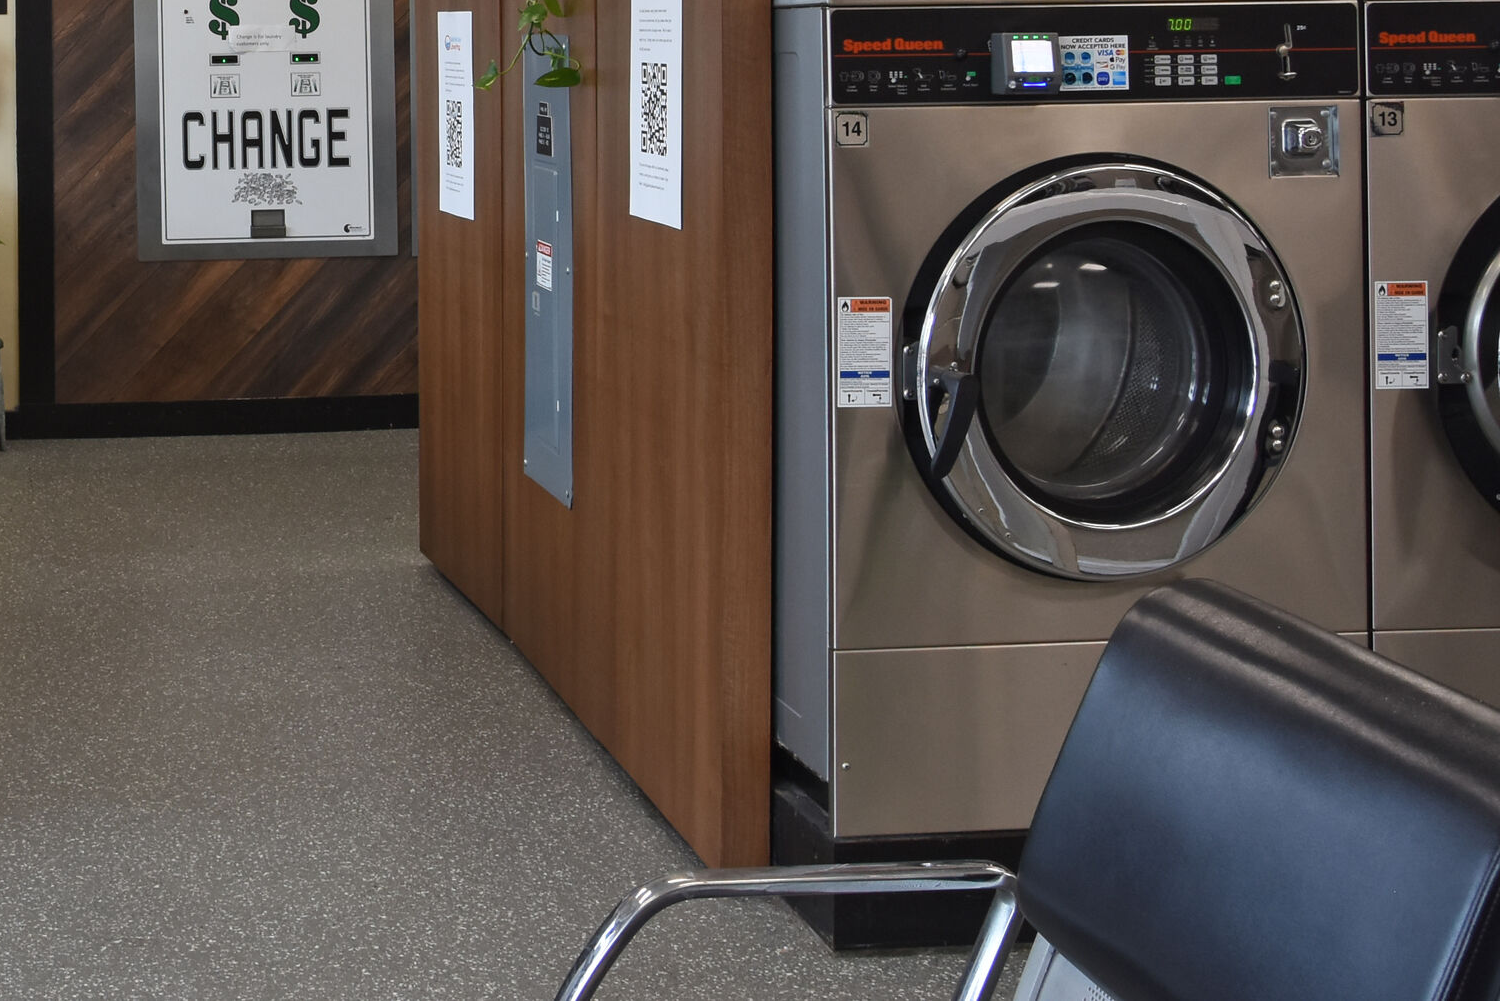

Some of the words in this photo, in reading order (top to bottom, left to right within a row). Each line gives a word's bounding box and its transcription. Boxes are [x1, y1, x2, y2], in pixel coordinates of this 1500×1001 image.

[843, 38, 891, 53] Speed
[894, 38, 944, 51] Queen
[1379, 31, 1426, 46] Speed
[1428, 30, 1476, 43] Queen
[1379, 112, 1397, 126] 13
[842, 121, 862, 136] 14
[182, 107, 352, 170] CHANGE
